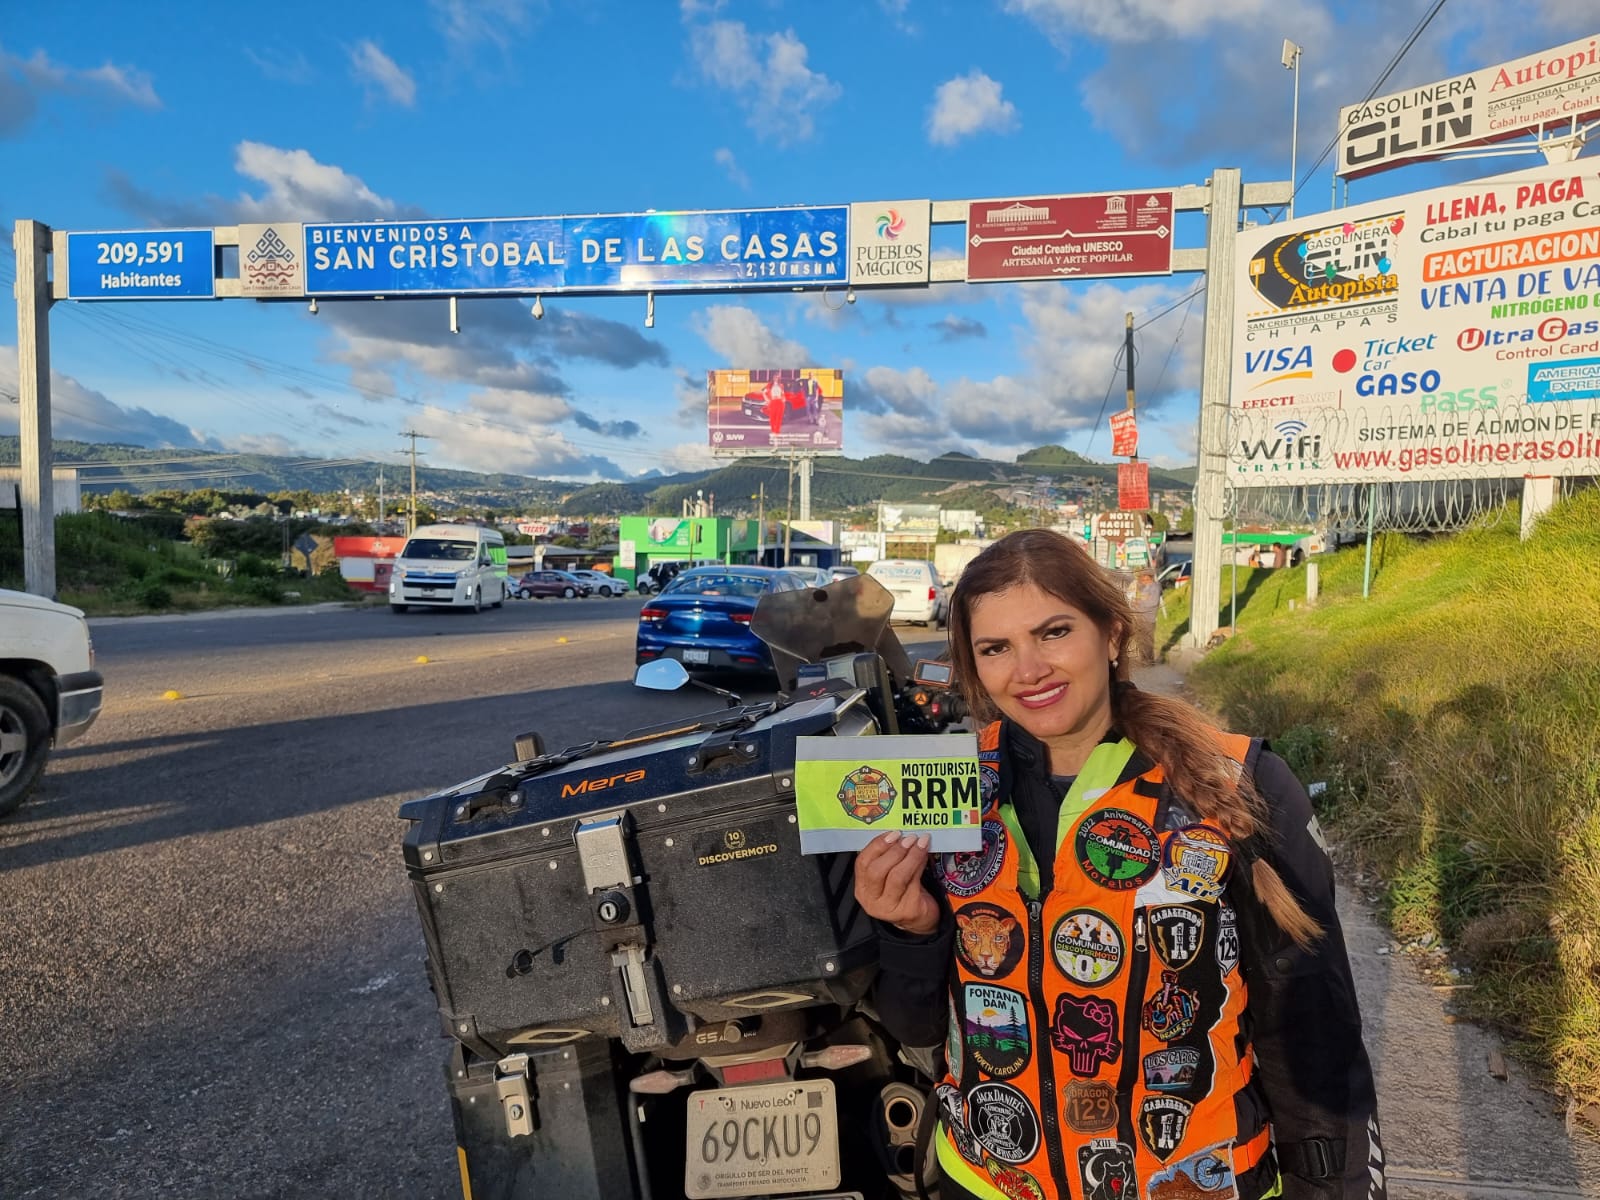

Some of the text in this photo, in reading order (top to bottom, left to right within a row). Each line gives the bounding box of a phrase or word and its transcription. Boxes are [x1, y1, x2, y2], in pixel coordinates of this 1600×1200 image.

[1489, 40, 1600, 93] Autopi
[1347, 76, 1477, 125] GASOLINERA
[1489, 115, 1517, 130] Cabal
[1520, 114, 1530, 123] tu
[1532, 106, 1560, 120] paga,
[1562, 96, 1593, 112] Cabal
[1346, 96, 1473, 166] OLIN
[1426, 175, 1584, 226] LLENA, PAGA
[312, 225, 472, 244] BIENVENIDOS A
[1306, 225, 1391, 252] GASOLINERA
[1420, 221, 1478, 244] Cabal
[1485, 219, 1506, 233] tu
[1513, 209, 1565, 232] paga
[97, 241, 184, 268] 209,591
[314, 231, 839, 271] SAN CRISTOBAL DE LAS CASAS
[1012, 240, 1124, 256] Ciudad Creativa UNESCO
[1055, 255, 1062, 265] Y
[1063, 254, 1088, 264] ARTE
[1089, 253, 1134, 263] POPULAR
[1428, 230, 1600, 279] FACTURACION
[101, 272, 182, 289] Habitantes
[1288, 273, 1399, 305] Autopista
[1420, 277, 1506, 310] VENTA
[1517, 269, 1552, 298] DE
[1323, 311, 1337, 321] DE
[1339, 308, 1360, 319] LAS
[1362, 303, 1399, 316] CASAS
[1364, 333, 1438, 358] Ticket
[1496, 341, 1599, 361] Control Card
[1245, 345, 1313, 374] VISA
[1363, 359, 1391, 372] Car
[1355, 370, 1441, 397] GASO
[1358, 425, 1437, 442] SISTEMA
[1443, 421, 1468, 437] DE
[1475, 416, 1550, 436] ADMON
[1554, 414, 1583, 430] DE
[1334, 432, 1600, 472] www.gasolinerasoli
[1238, 461, 1321, 473] GRATIS
[901, 761, 977, 777] MOTOTURISTA
[561, 768, 647, 799] Mera
[901, 777, 979, 810] RRM
[902, 811, 949, 827] MÉXICO
[728, 831, 740, 841] 10
[1078, 811, 1161, 862] 2022 Aniversario 2022
[1088, 832, 1151, 858] COMUNIDAD
[698, 844, 778, 866] DISCOVERMOTO
[1082, 859, 1143, 889] Morelos
[1169, 878, 1212, 897] Air
[1057, 935, 1118, 954] COMUNIDAD
[1218, 937, 1238, 961] 129
[969, 988, 1020, 1005] FONTANA
[983, 998, 1008, 1011] DAM
[696, 1031, 718, 1045] GS
[973, 1050, 1026, 1077] NORTH CAROLINA
[1147, 1049, 1200, 1070] LOS CABOS
[741, 1099, 771, 1111] Nuevo
[976, 1090, 994, 1105] JACK
[1071, 1088, 1109, 1098] DRAGON
[1072, 1098, 1110, 1121] 129
[701, 1112, 822, 1164] 69CKU9
[1095, 1139, 1111, 1148] XIII
[715, 1167, 809, 1180] ORGULLO DE SER DEL NORTE
